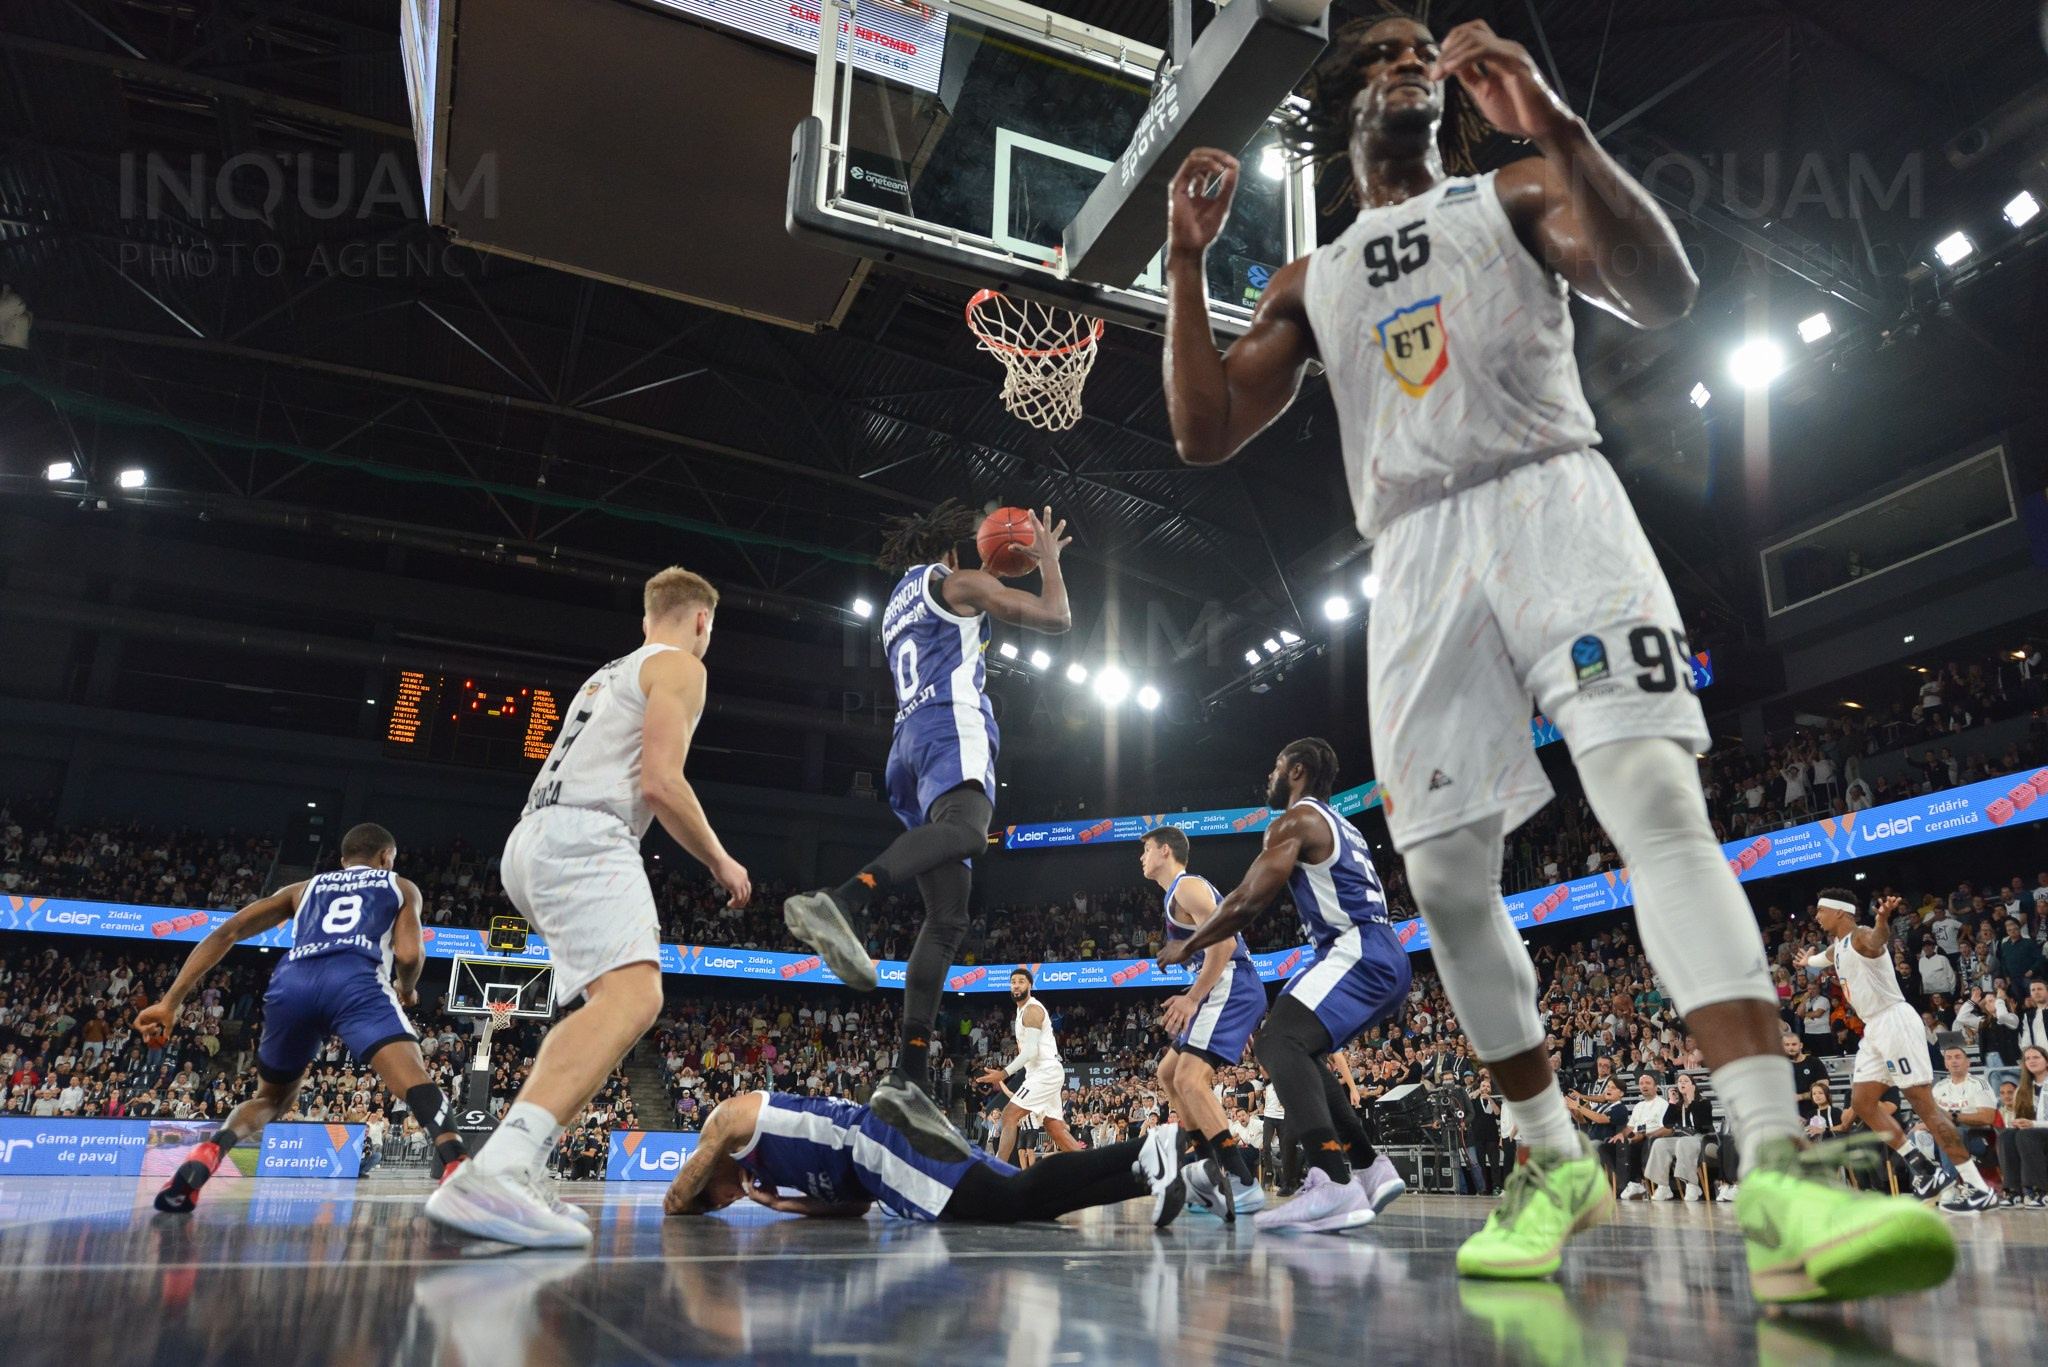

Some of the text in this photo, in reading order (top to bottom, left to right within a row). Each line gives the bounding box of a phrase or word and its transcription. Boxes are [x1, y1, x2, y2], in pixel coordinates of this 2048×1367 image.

[1122, 101, 1179, 187] sports
[865, 175, 907, 191] oneteam
[1363, 218, 1431, 288] 95
[897, 638, 919, 702] 0
[1927, 798, 1969, 815] Zidărie
[1862, 814, 1921, 841] Leier
[1925, 812, 1978, 833] ceramică
[1017, 831, 1048, 842] Leier
[1774, 832, 1811, 846] Rezistență
[1775, 840, 1821, 857] superioară la
[1777, 851, 1822, 867] compresiune
[1507, 902, 1524, 912] idărie
[1572, 899, 1606, 911] compresiune
[45, 909, 101, 925] Leier
[108, 910, 142, 921] Zidărie
[322, 895, 363, 934] 8
[100, 921, 145, 932] ceramică
[437, 939, 468, 948] superioară
[438, 932, 469, 941] Rezistență
[436, 946, 475, 955] compresiune
[522, 943, 549, 956] eier
[705, 955, 743, 969] Leier
[748, 956, 773, 965] Zidărie
[744, 965, 776, 974] ceramică
[1042, 971, 1077, 982] Leier
[1081, 967, 1104, 975] Zidărie
[1078, 975, 1107, 984] ceramică
[1898, 1057, 1912, 1075] 0
[1016, 1086, 1030, 1099] 11
[36, 1132, 146, 1149] Gama premium
[267, 1137, 303, 1149] 5 ani
[58, 1149, 118, 1165] de pavaj
[264, 1155, 328, 1171] Garanție
